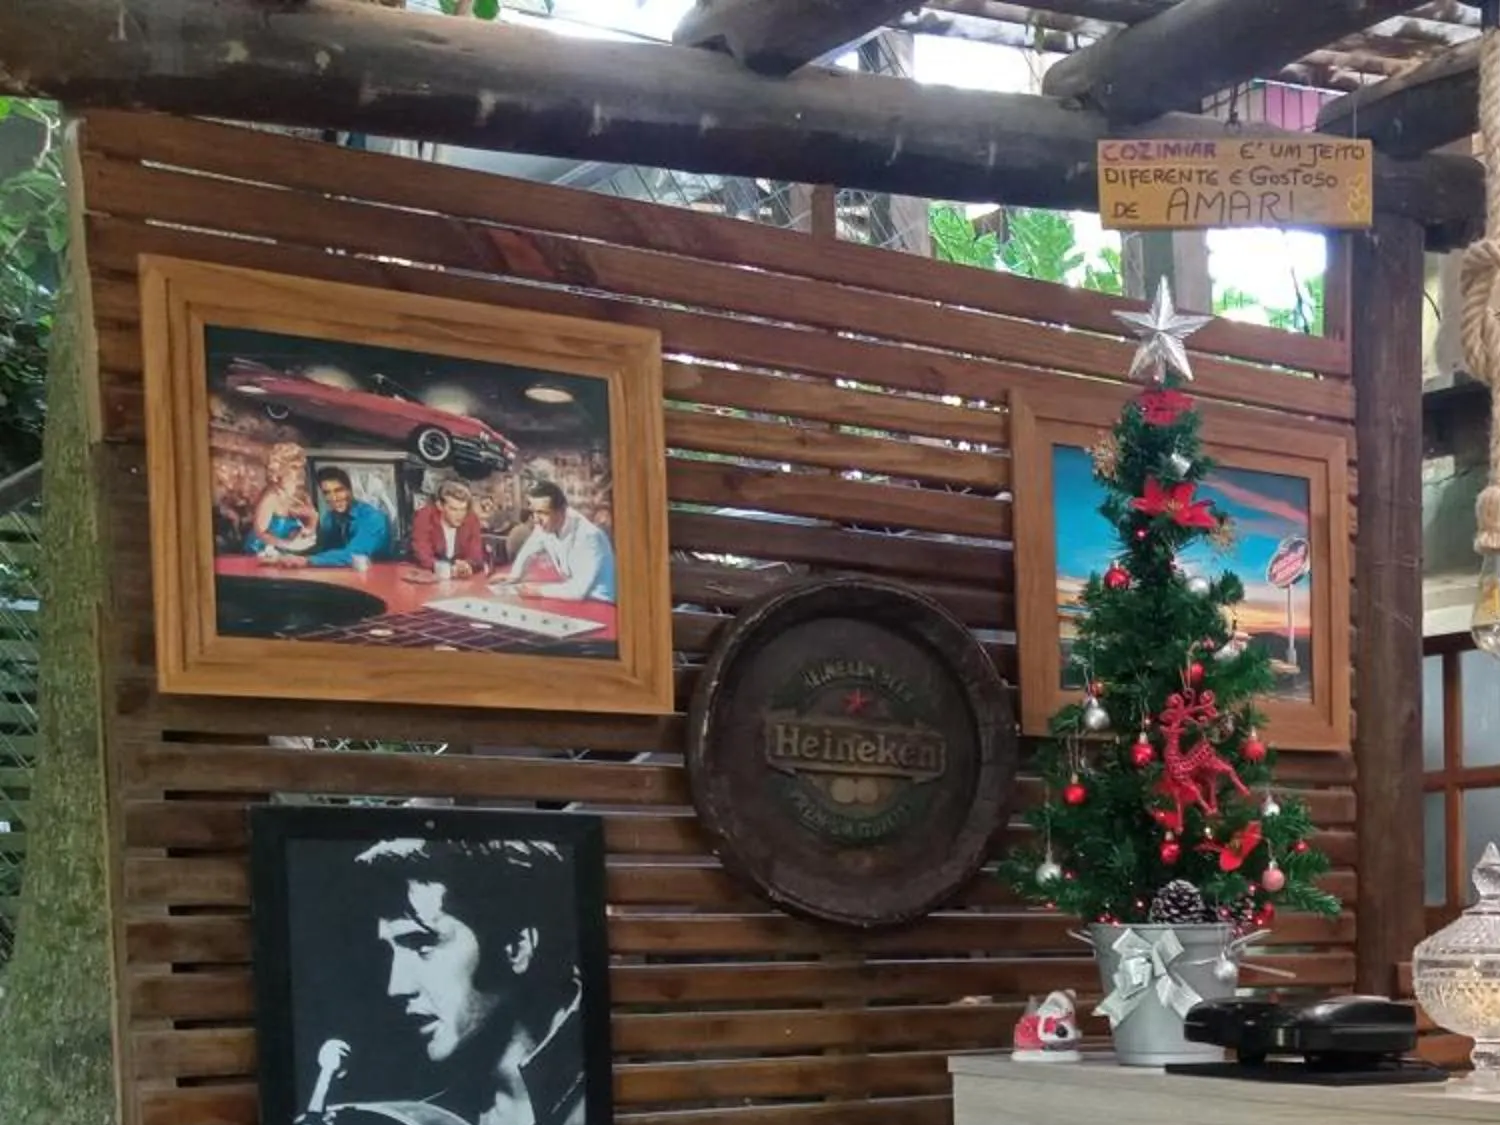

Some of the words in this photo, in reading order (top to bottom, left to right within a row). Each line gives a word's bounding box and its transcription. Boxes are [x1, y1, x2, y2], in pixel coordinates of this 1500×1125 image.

[1270, 143, 1300, 158] UM
[1104, 167, 1219, 187] DIFERENTE
[1229, 170, 1241, 185] E
[1112, 202, 1140, 219] DE
[774, 723, 936, 768] Heineken
